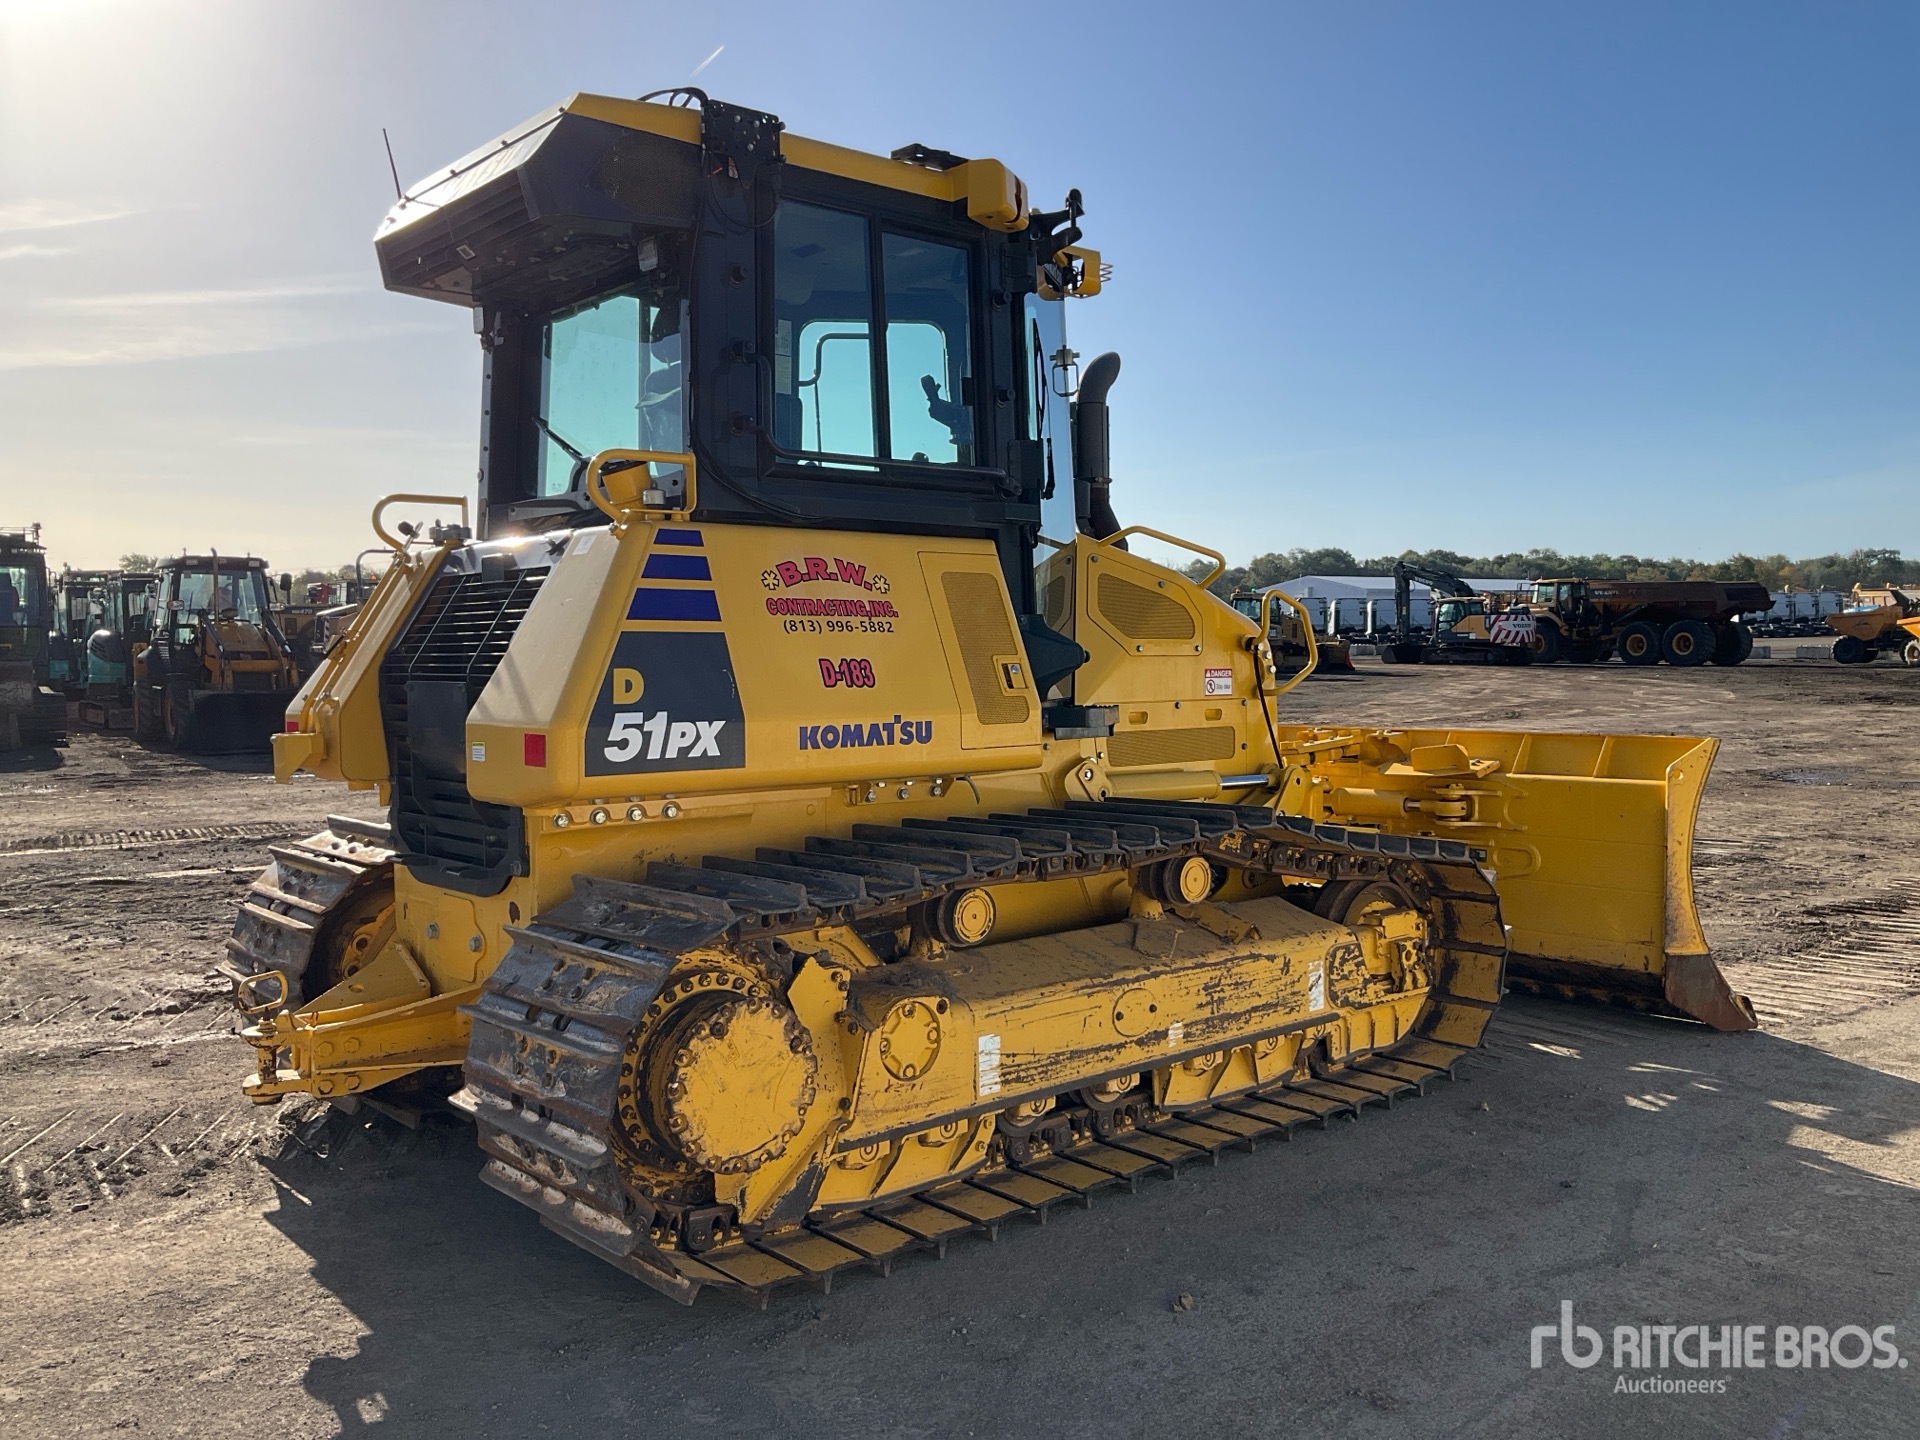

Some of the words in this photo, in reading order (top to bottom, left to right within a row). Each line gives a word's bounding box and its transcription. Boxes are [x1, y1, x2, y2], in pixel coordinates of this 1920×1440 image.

[775, 557, 873, 592] B.R.W.
[783, 619, 823, 634] (813)
[826, 620, 894, 633] 996-5882
[612, 668, 645, 705] D
[819, 657, 875, 688] D-183
[1210, 669, 1231, 677] DANGER
[800, 714, 932, 750] KOMATSU
